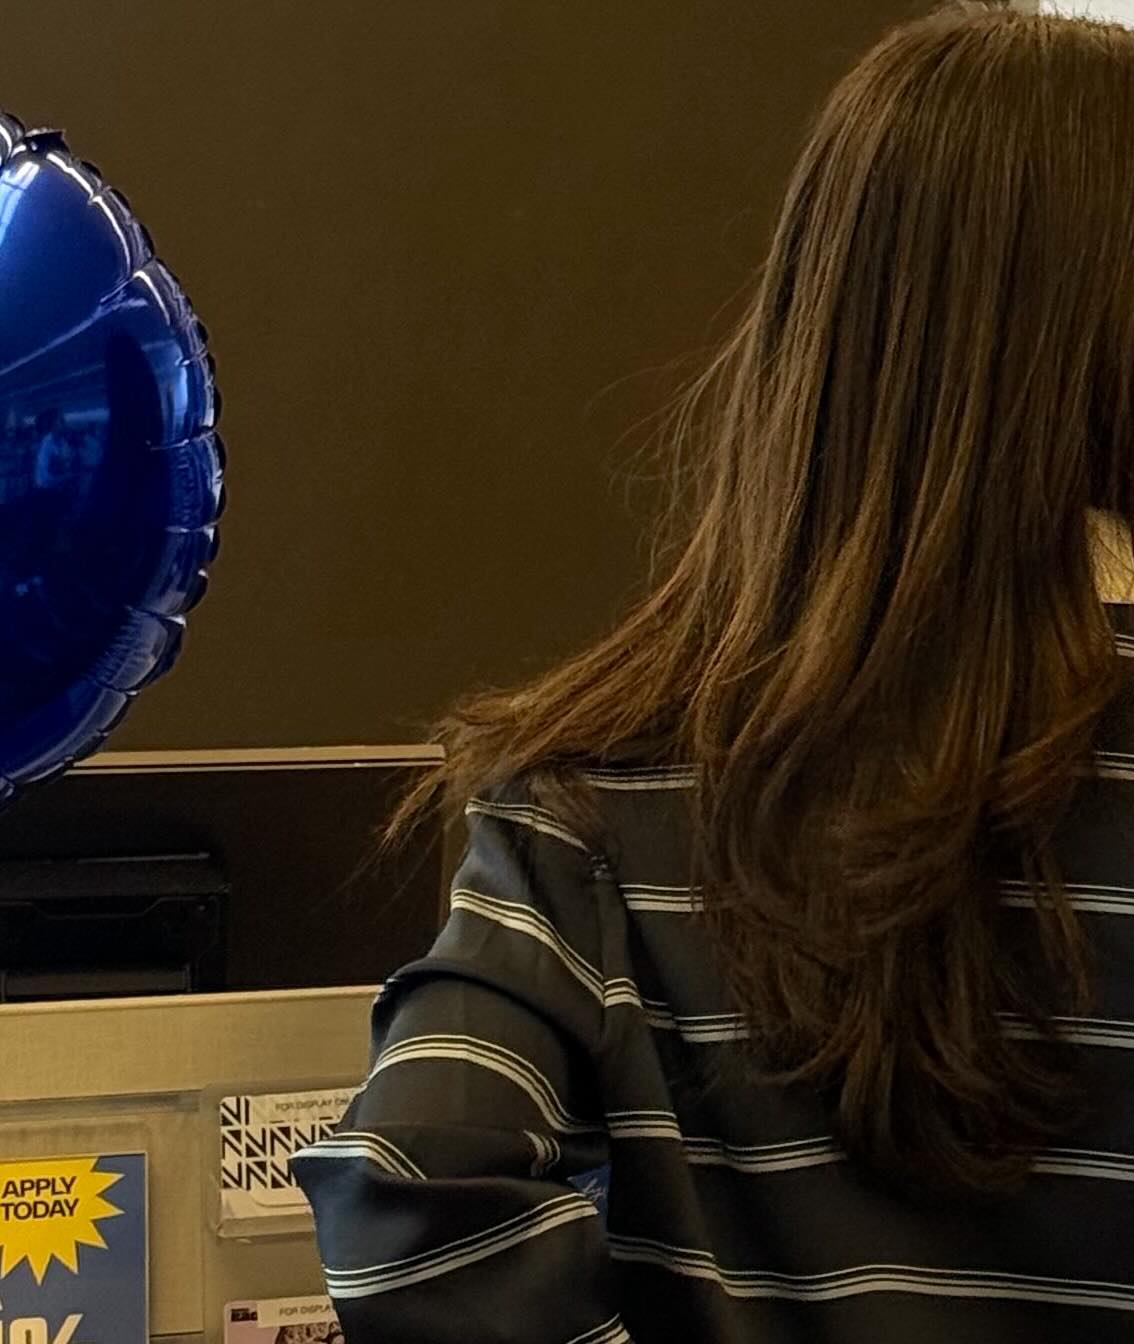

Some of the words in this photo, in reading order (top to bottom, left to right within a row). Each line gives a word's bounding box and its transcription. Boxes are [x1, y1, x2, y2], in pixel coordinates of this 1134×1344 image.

[2, 1175, 78, 1200] APPLY
[0, 1197, 80, 1222] TODAY
[300, 1303, 332, 1315] DISPLA
